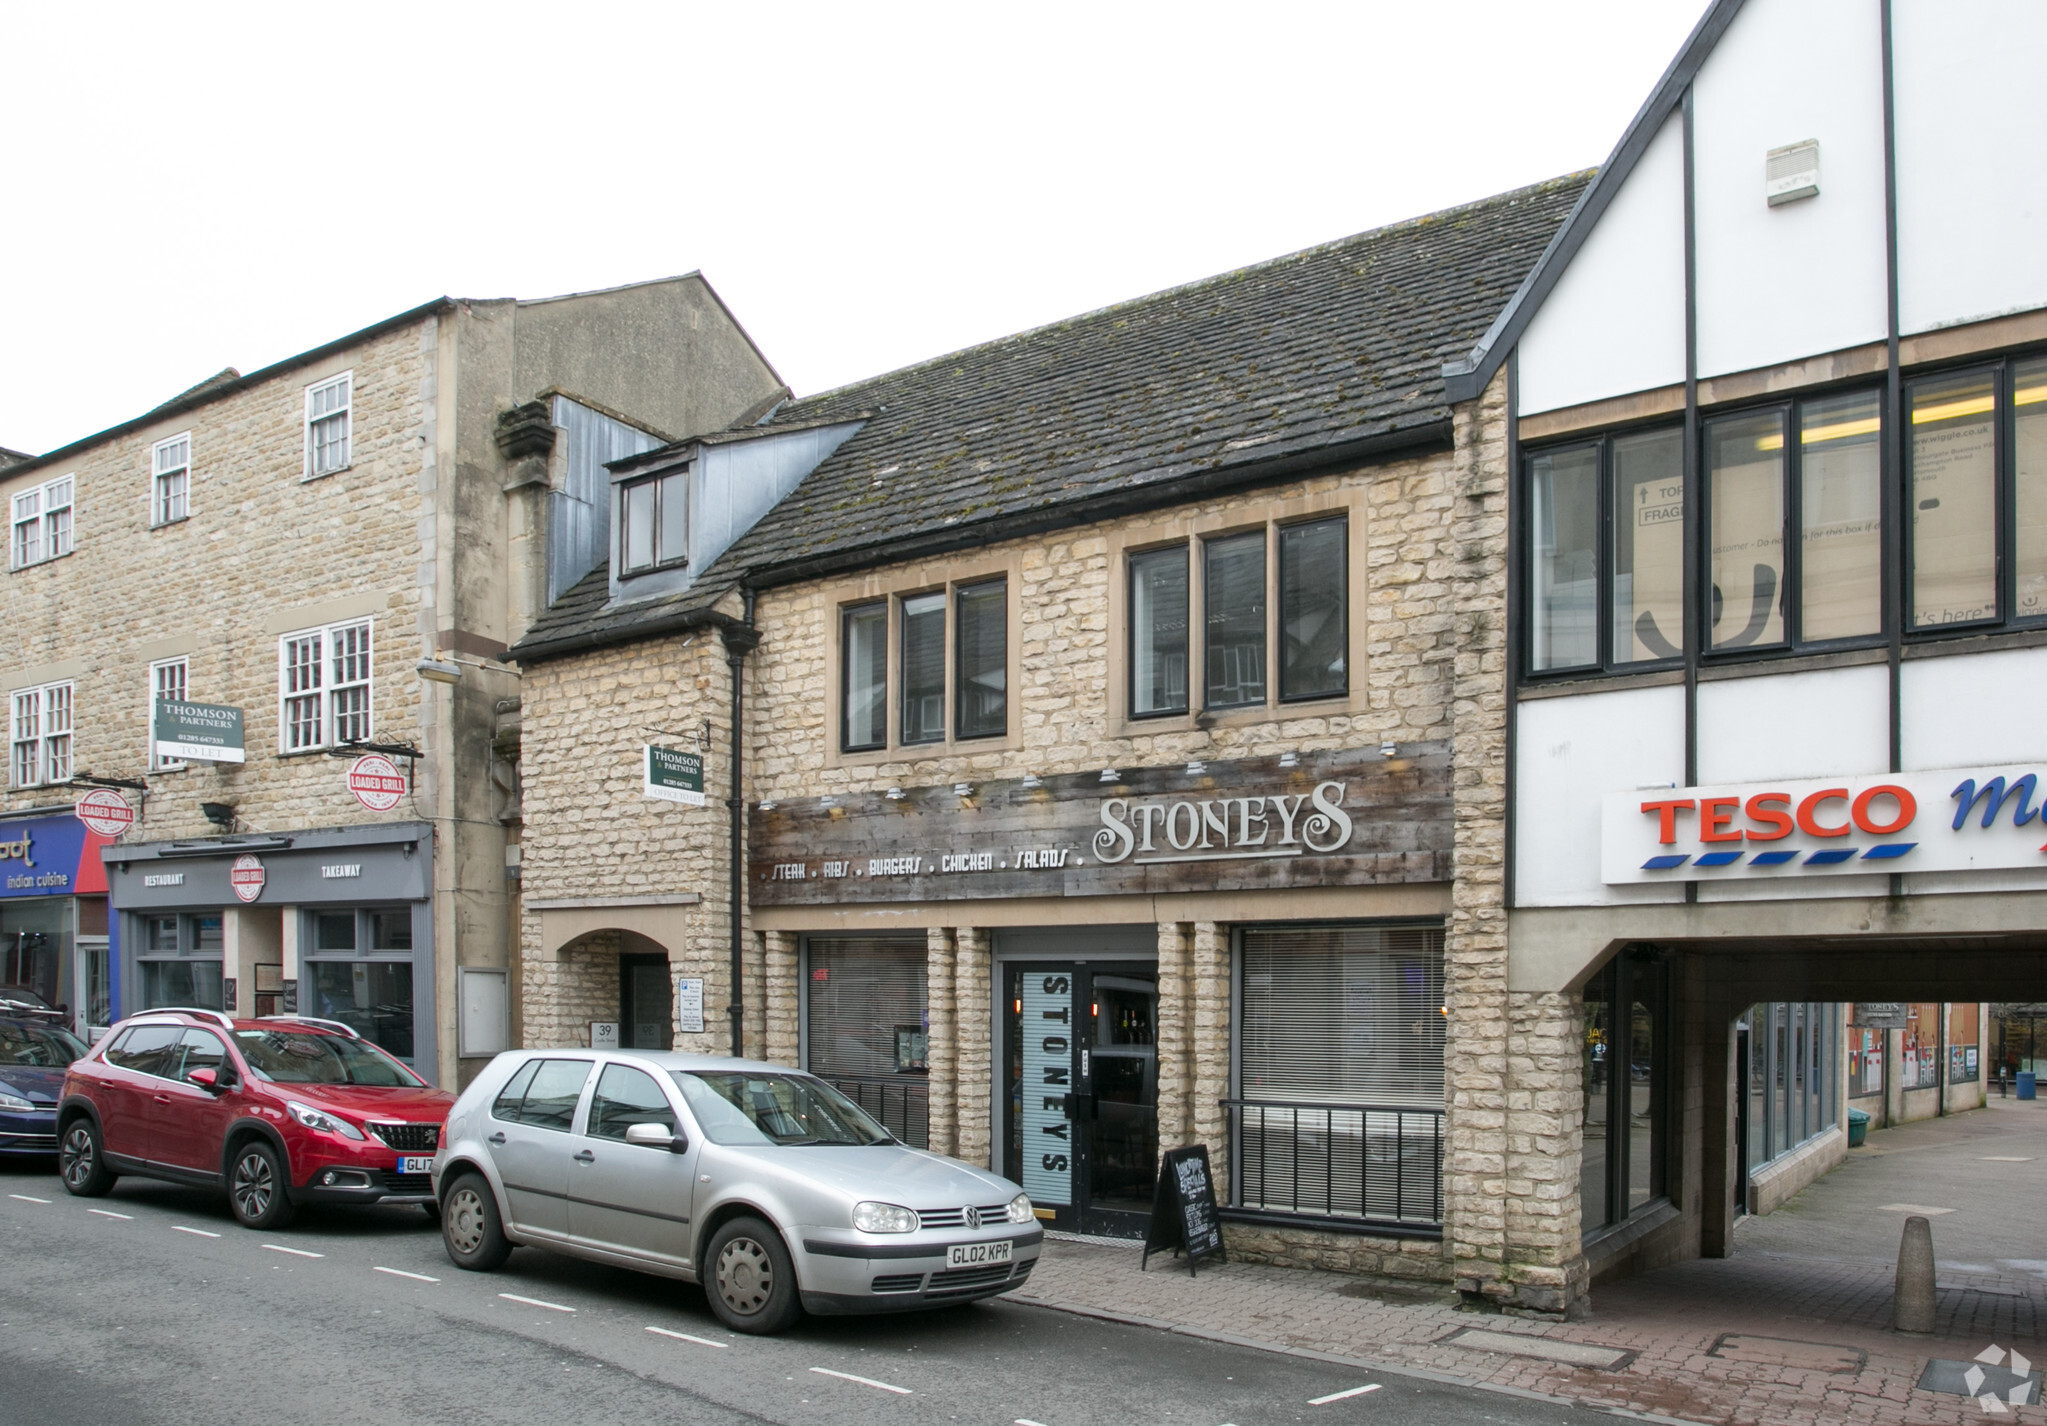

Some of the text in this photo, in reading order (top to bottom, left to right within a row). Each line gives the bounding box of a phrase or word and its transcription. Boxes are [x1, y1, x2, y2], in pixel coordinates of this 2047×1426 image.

[163, 704, 237, 720] THOMSON
[180, 716, 232, 728] PARTNERS
[178, 734, 198, 742] 01285
[179, 745, 223, 758] TO LET
[654, 751, 700, 767] THOMSON
[664, 762, 697, 774] PARTNERS
[351, 775, 403, 791] LOADED GRILL
[81, 804, 132, 820] LOADED GRILL
[1640, 773, 2047, 844] TESCO M
[1092, 781, 1353, 863] STONEYS
[321, 864, 361, 878] TAKEAWAY
[771, 848, 1068, 880] STEAK RIBS BURGERS CHICKEN SALADS
[7, 871, 68, 889] indian cuisine
[144, 873, 184, 887] RESTAURANT
[599, 1025, 611, 1036] 39
[1042, 976, 1069, 1172] STONEYS
[407, 1159, 433, 1170] GL17
[953, 1243, 1009, 1264] GL02 KPR
